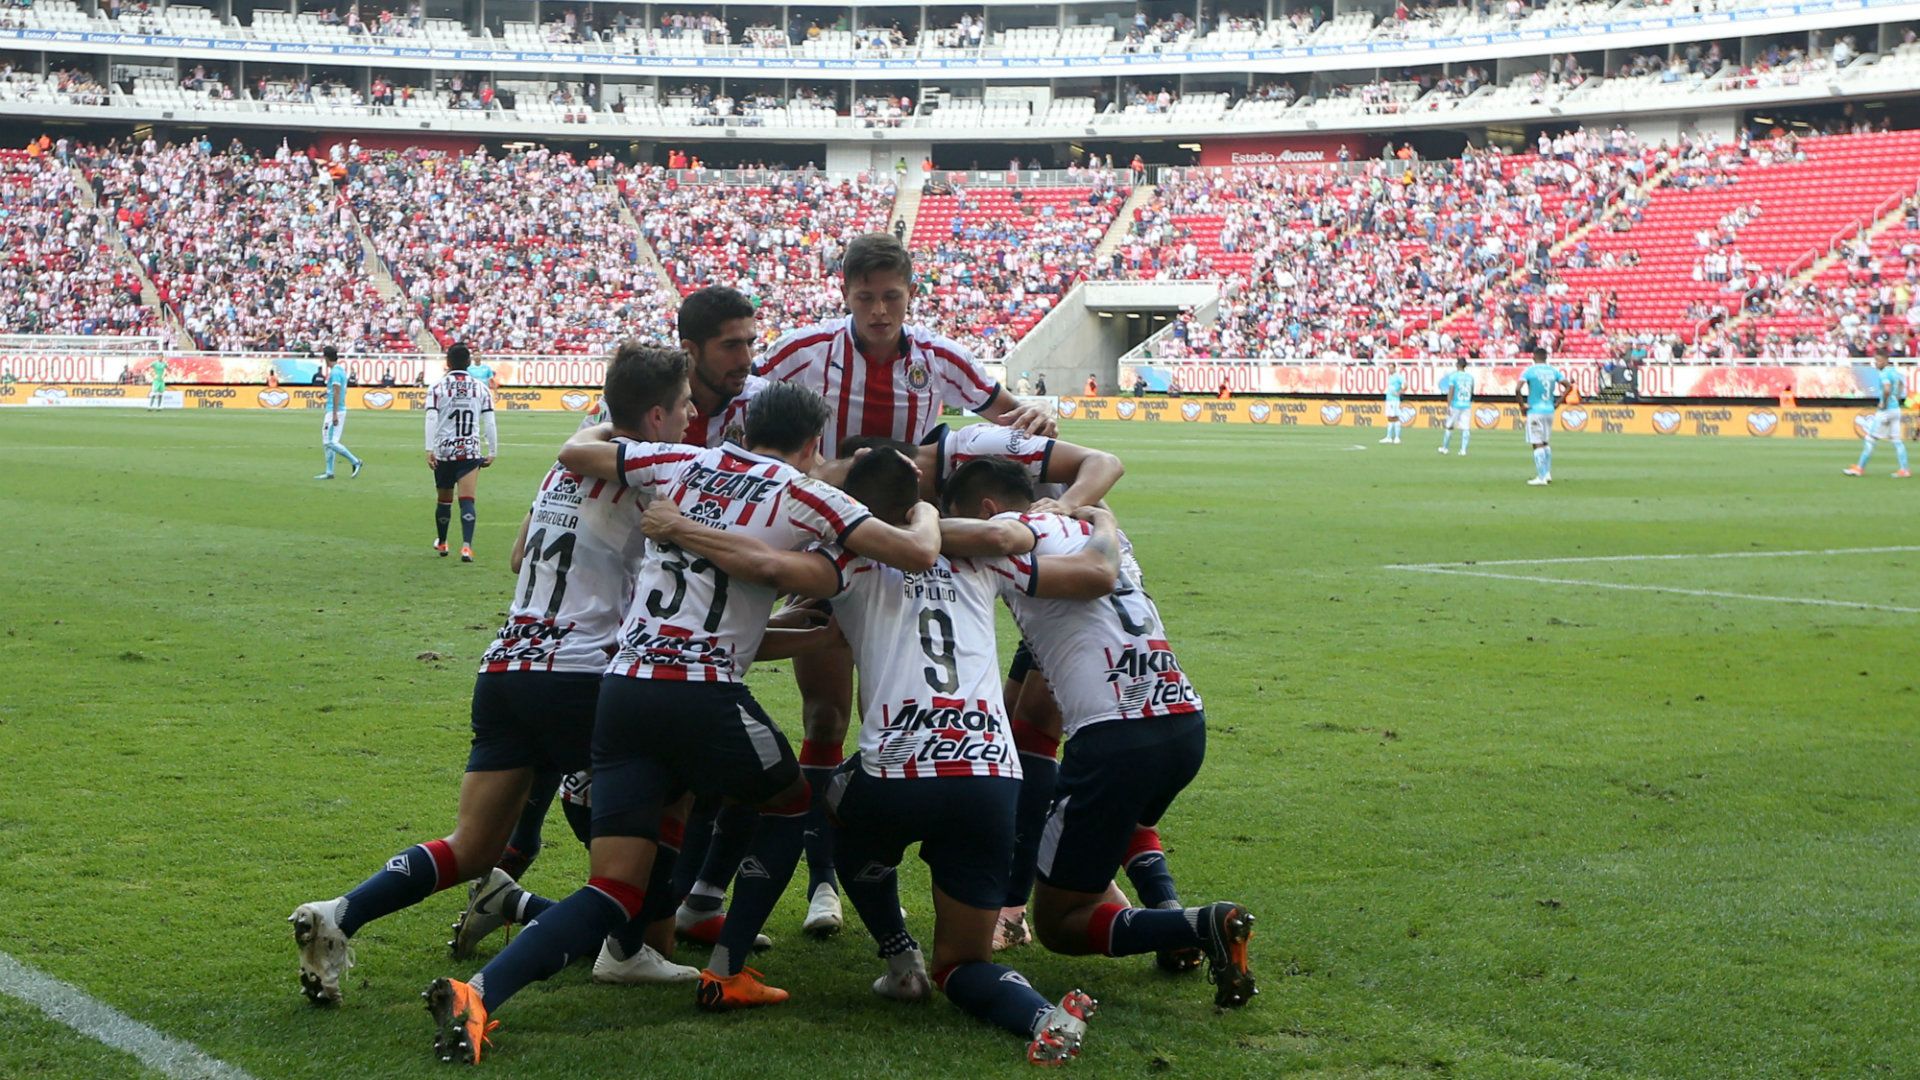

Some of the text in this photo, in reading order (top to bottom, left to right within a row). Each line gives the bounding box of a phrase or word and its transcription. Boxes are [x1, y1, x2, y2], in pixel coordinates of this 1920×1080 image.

[1231, 150, 1325, 164] Estadio AKRON
[72, 385, 126, 398] mercado
[185, 387, 236, 399] mercado
[198, 398, 223, 409] libre
[507, 401, 530, 410] libre
[1079, 399, 1108, 409] mercado
[1138, 400, 1168, 410] mercado
[1203, 402, 1236, 412] mercado
[1273, 403, 1307, 413] mercado
[1345, 404, 1381, 415] mercado
[1591, 407, 1635, 420] mercado
[1685, 408, 1732, 422] mercado
[1782, 409, 1832, 424] mercado
[448, 408, 474, 437] 10
[680, 461, 781, 503] TECATE
[524, 528, 577, 620] 11
[919, 607, 960, 696] 9
[916, 736, 1009, 764] telcel
